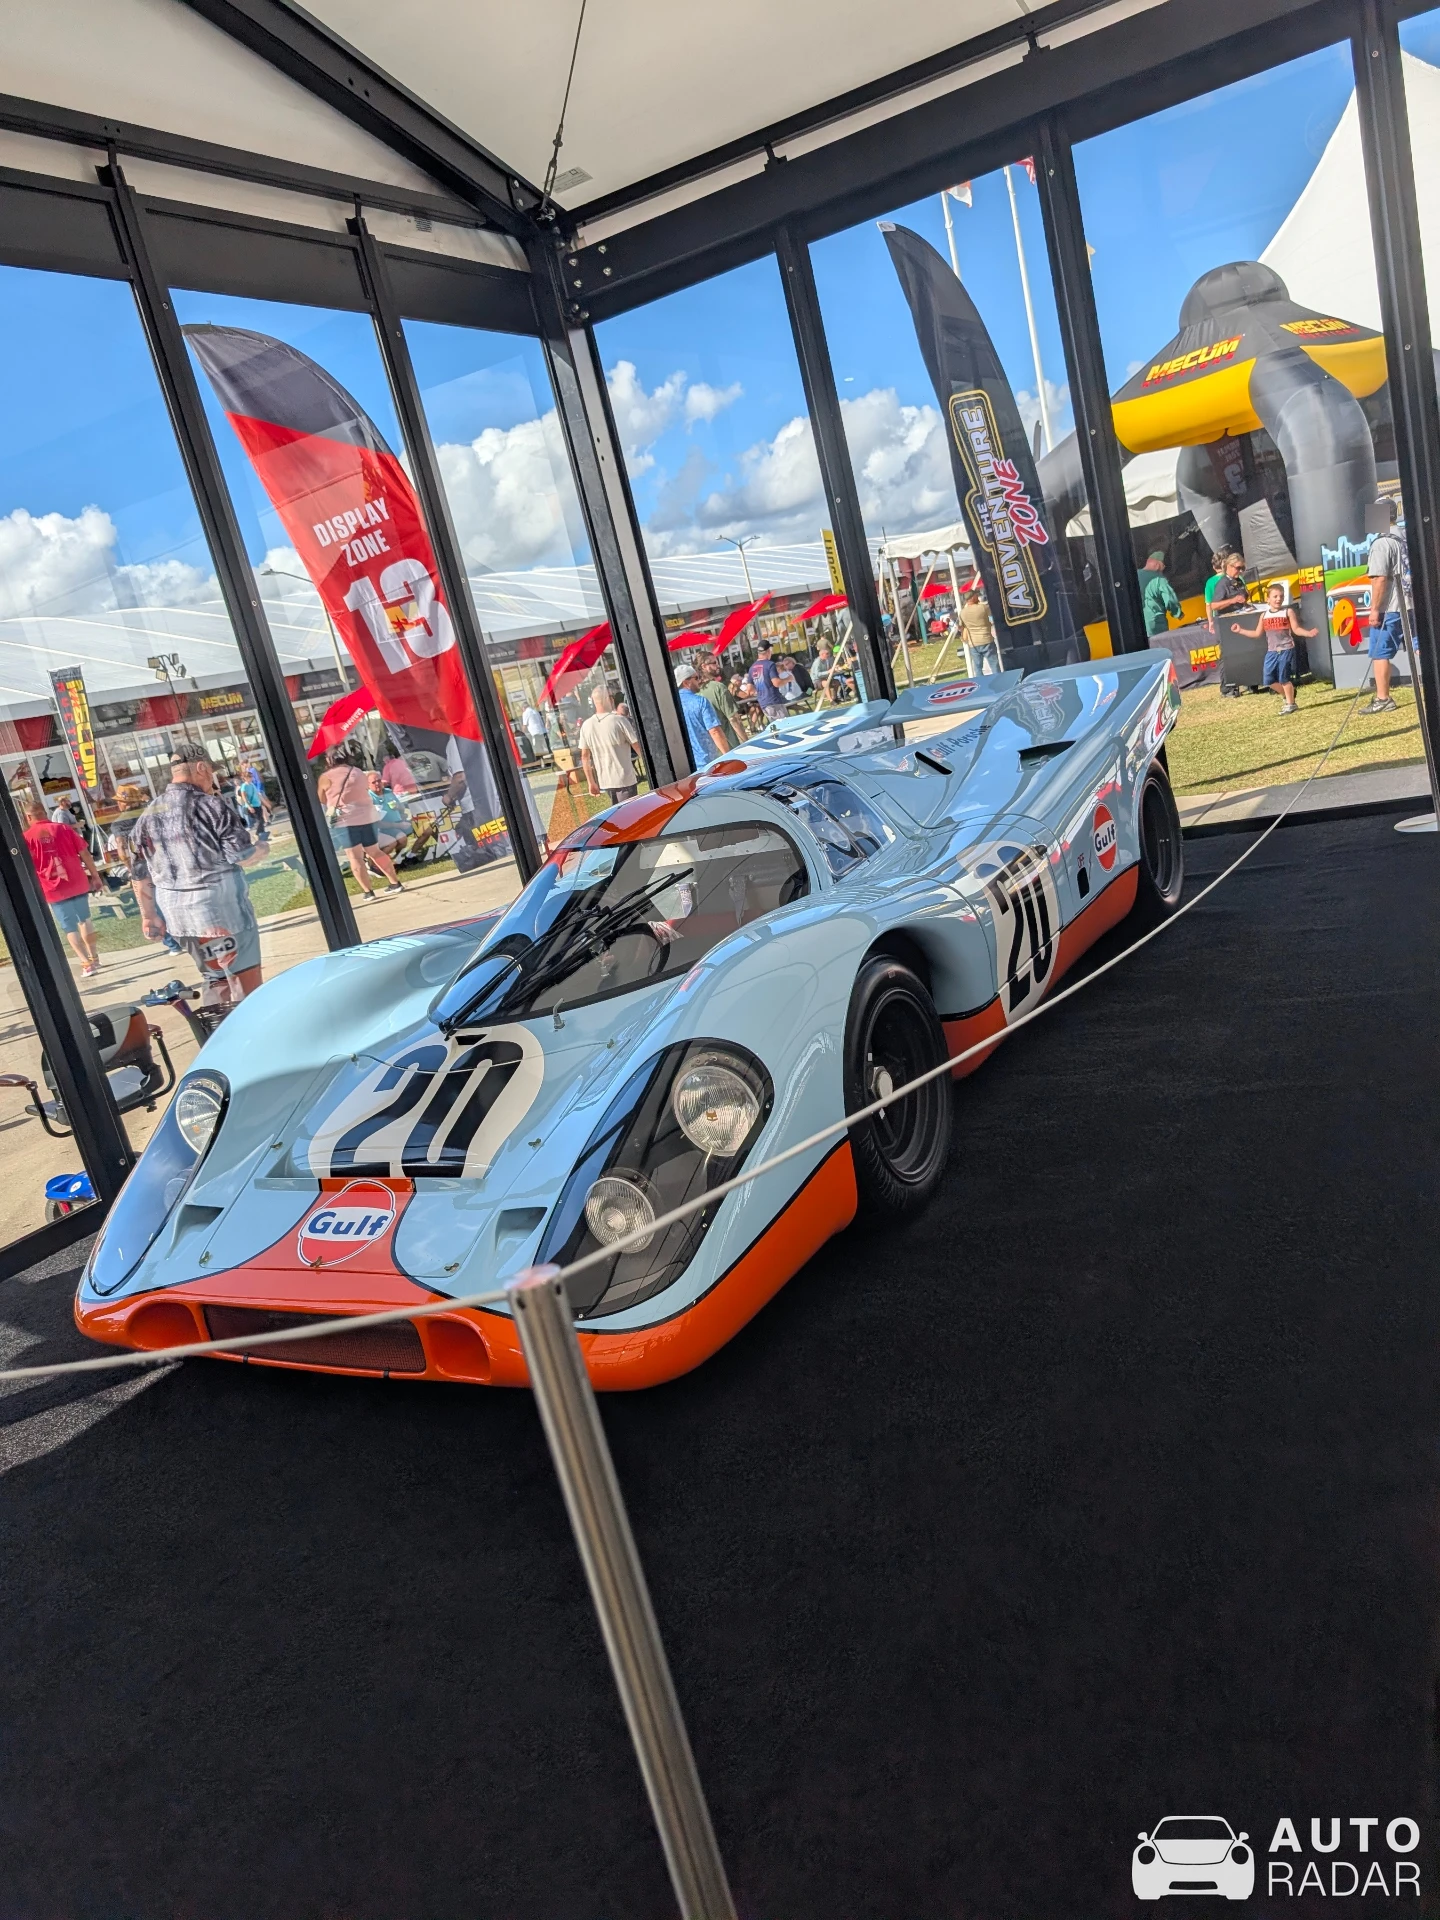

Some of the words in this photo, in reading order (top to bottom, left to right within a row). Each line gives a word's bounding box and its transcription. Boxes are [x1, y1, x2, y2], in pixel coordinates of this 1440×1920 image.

[1279, 318, 1351, 335] MECUM
[1145, 336, 1241, 382] MECUM
[312, 497, 390, 548] DISPLAY
[961, 406, 1033, 608] ADVENTURE
[978, 501, 993, 538] THE
[992, 459, 1050, 547] ZONE
[340, 528, 391, 568] ZONE
[343, 558, 456, 675] 13
[200, 691, 244, 710] MECUM
[929, 686, 979, 699] Gulf
[66, 679, 98, 788] MECUM
[1094, 823, 1116, 852] Gulf
[975, 846, 1053, 1014] 20
[329, 1039, 524, 1178] 20
[308, 1209, 389, 1236] Gulf
